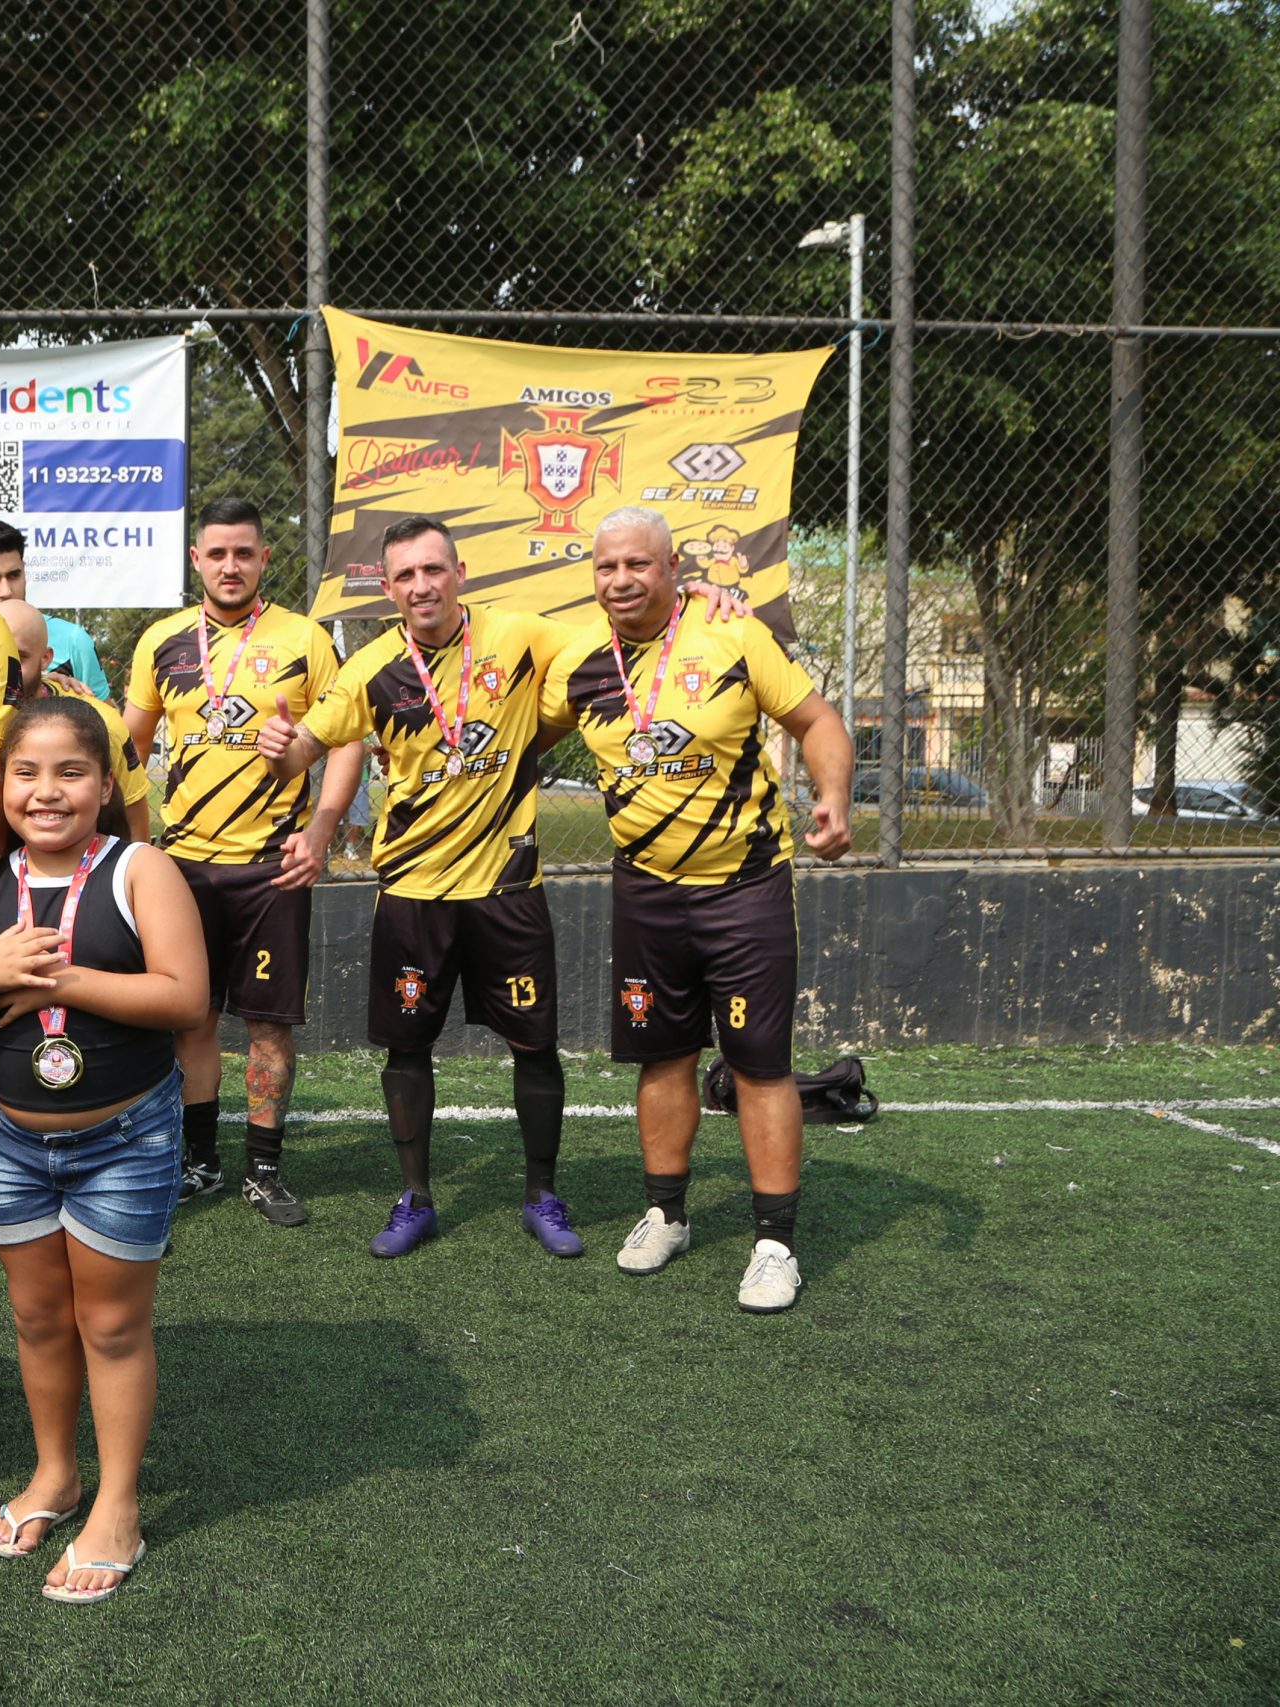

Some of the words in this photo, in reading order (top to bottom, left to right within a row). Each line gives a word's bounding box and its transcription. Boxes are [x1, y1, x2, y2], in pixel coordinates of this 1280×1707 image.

[404, 377, 469, 399] WFG
[520, 386, 611, 405] AMIGOS
[3, 421, 56, 431] como
[71, 417, 132, 430] sorrir
[28, 467, 50, 484] 11
[56, 466, 164, 484] 93232-8778
[255, 949, 271, 980] 2
[506, 975, 537, 1007] 13
[729, 995, 747, 1029] 8
